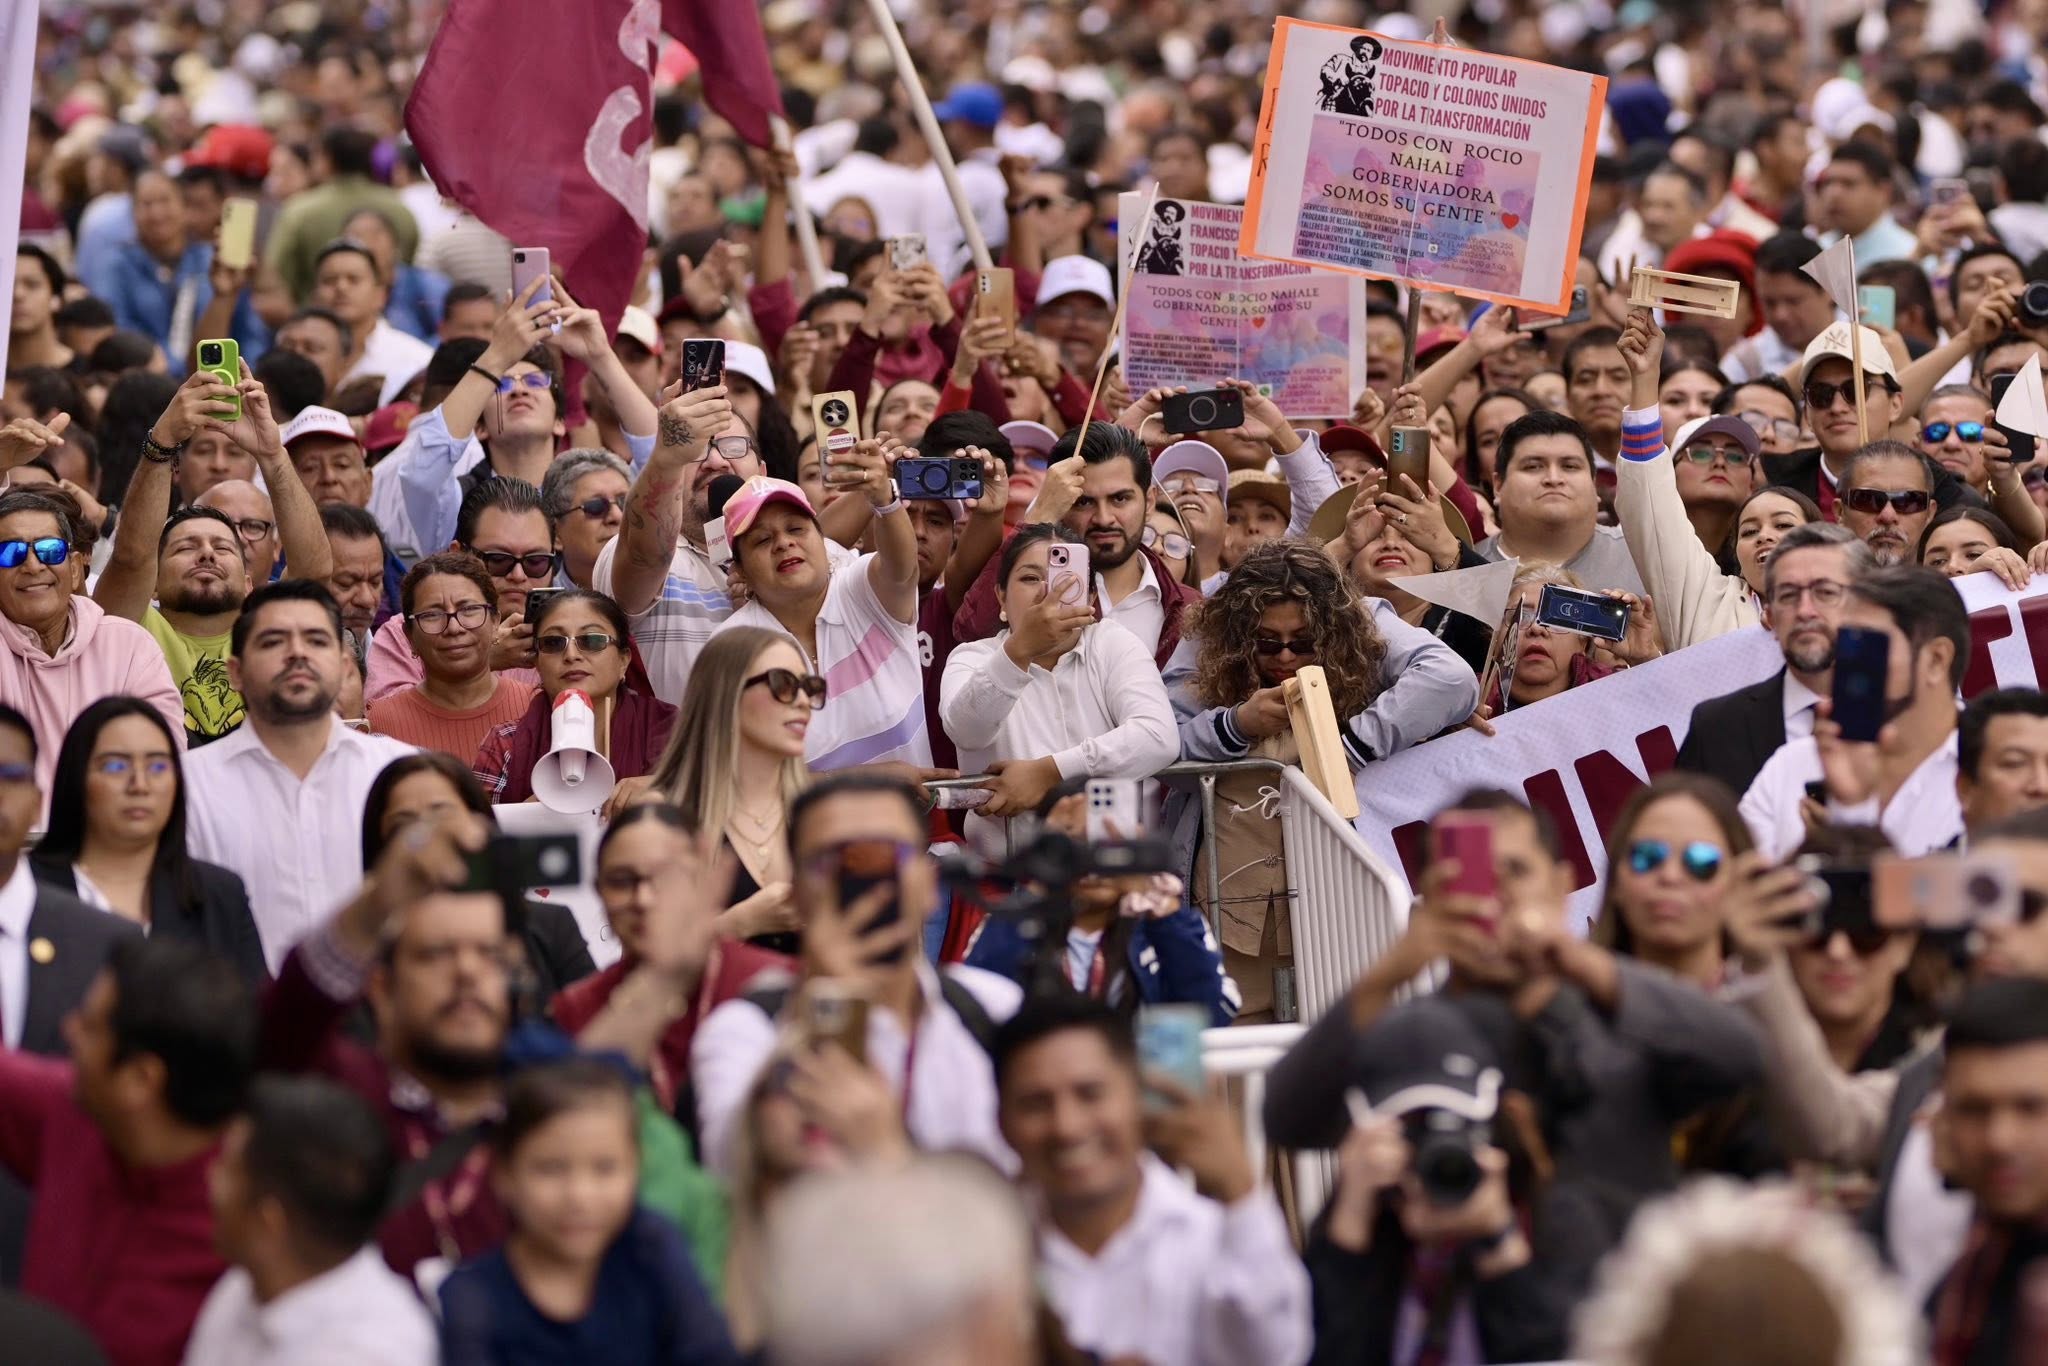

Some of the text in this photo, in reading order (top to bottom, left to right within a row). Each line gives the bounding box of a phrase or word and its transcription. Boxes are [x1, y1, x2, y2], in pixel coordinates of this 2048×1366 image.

[1382, 48, 1517, 88] MOVIMIENTO POPULAR
[1379, 73, 1547, 119] TOPACIO Y COLONOS UNIDOS
[1375, 98, 1531, 141] POR LA TRANSFORMACIÓN
[1413, 135, 1453, 154] CON
[1464, 144, 1523, 166] ROCIO
[1390, 152, 1465, 178] NAHALE
[1353, 167, 1496, 204] GOBERNADORA
[1191, 205, 1243, 223] MOVIMIENT
[1322, 184, 1389, 207] SOMOS
[1394, 196, 1416, 213] SU
[1423, 201, 1484, 224] GENTE
[1190, 224, 1239, 241] FRANCISC
[1190, 243, 1230, 260] TOPACIO
[1189, 262, 1208, 276] POR
[1210, 264, 1222, 278] LA
[1153, 300, 1312, 316] GOBERNADORA SOMOS SU
[1195, 290, 1222, 301] CON
[1228, 291, 1268, 303] ROCIO
[1271, 287, 1320, 300] NAHALE
